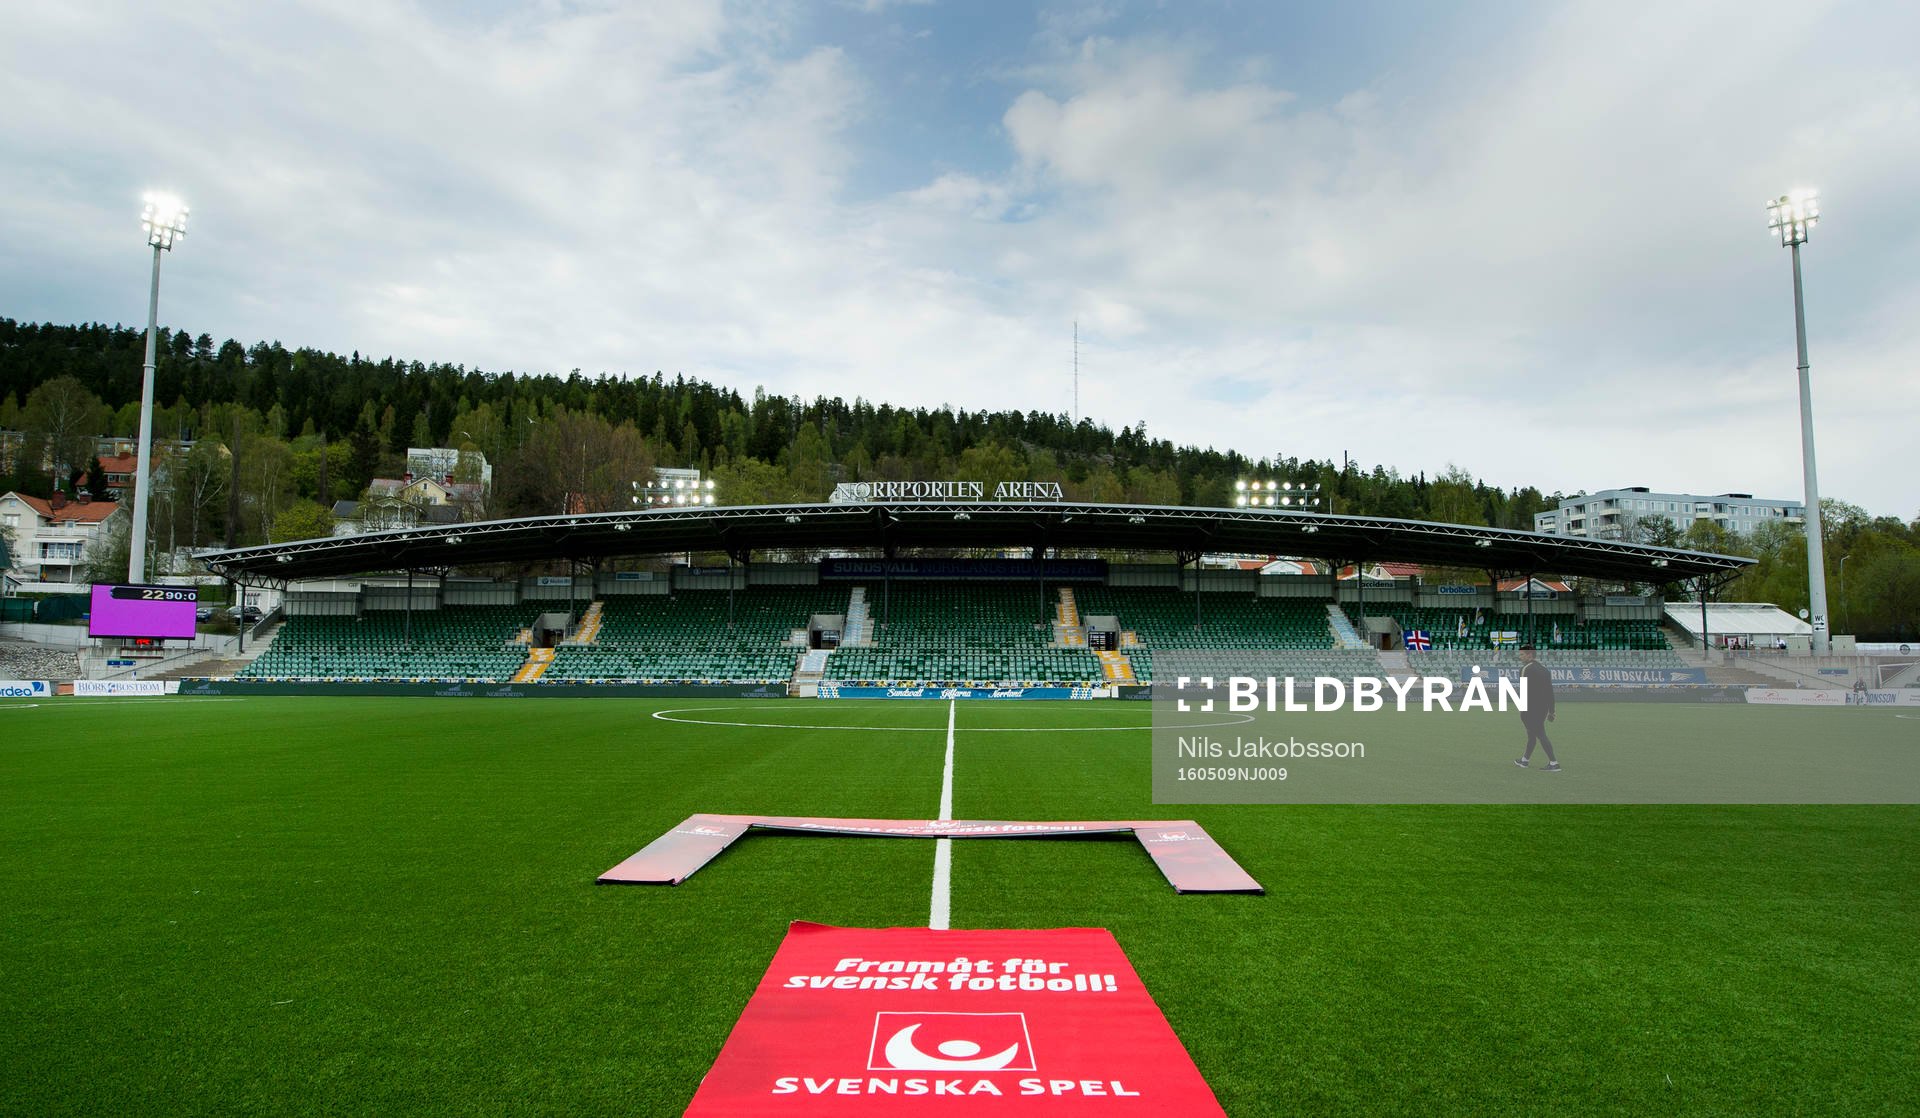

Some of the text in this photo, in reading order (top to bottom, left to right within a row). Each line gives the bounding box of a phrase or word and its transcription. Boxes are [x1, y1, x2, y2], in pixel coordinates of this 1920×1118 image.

[836, 481, 1064, 499] NORRPORTEN ARENA
[833, 562, 918, 573] SUNDSVALL
[1599, 670, 1665, 682] SUNDSVALL
[0, 686, 32, 697] rdea
[833, 957, 1069, 974] Framåt för
[783, 973, 1118, 992] svensk fotboll!
[772, 1077, 1140, 1096] SVENSKA SPEL
